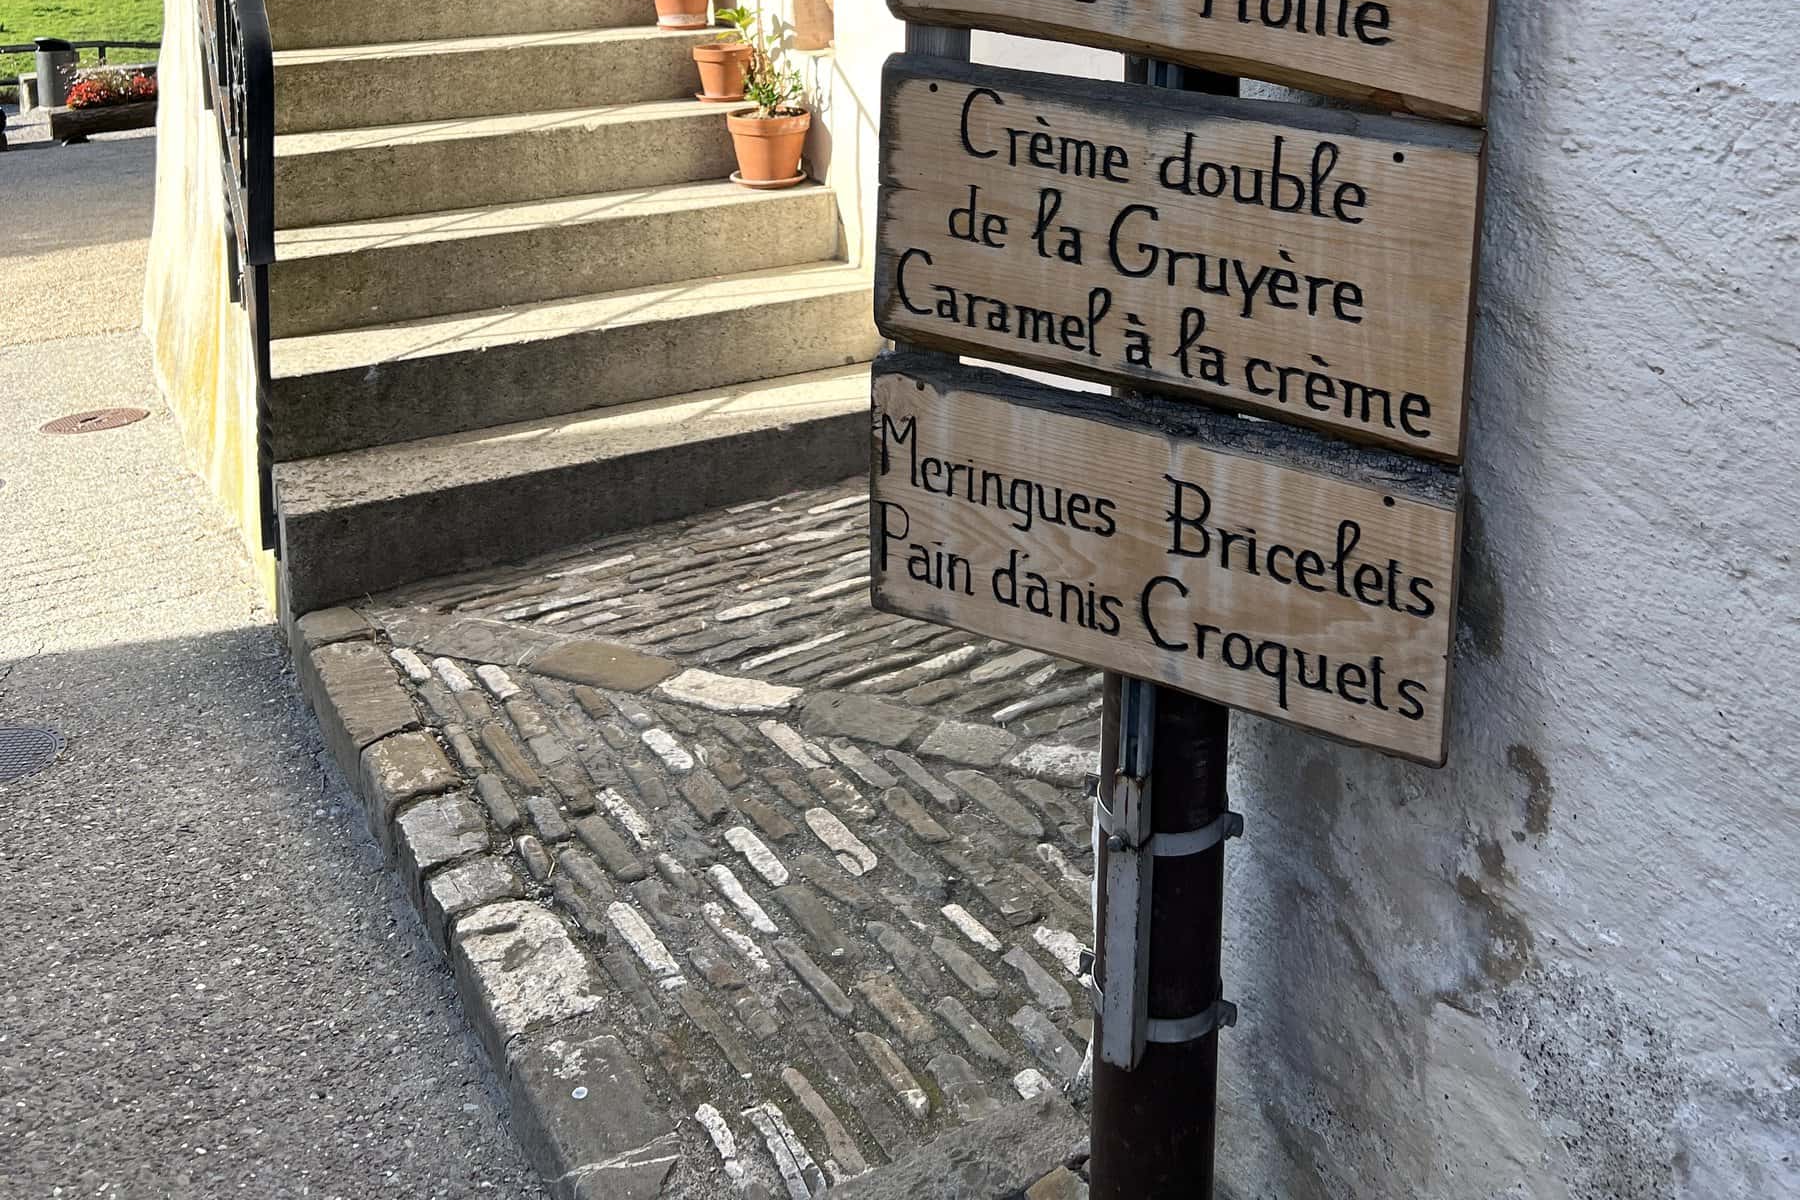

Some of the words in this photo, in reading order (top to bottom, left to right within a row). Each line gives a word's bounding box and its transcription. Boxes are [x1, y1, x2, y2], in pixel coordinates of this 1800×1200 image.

[960, 87, 1129, 184] Crème
[1158, 131, 1369, 225] double
[896, 247, 1112, 357] Caramel
[1123, 312, 1153, 369] à
[1170, 306, 1231, 387] la
[1243, 353, 1432, 439] crème
[948, 184, 1009, 249] de
[1031, 187, 1083, 266] la
[1108, 203, 1365, 324] Gruyère
[879, 501, 975, 597] Pain
[1138, 574, 1428, 721] Croquets
[880, 412, 1117, 538] Meringues
[1162, 472, 1436, 619] Bricelets
